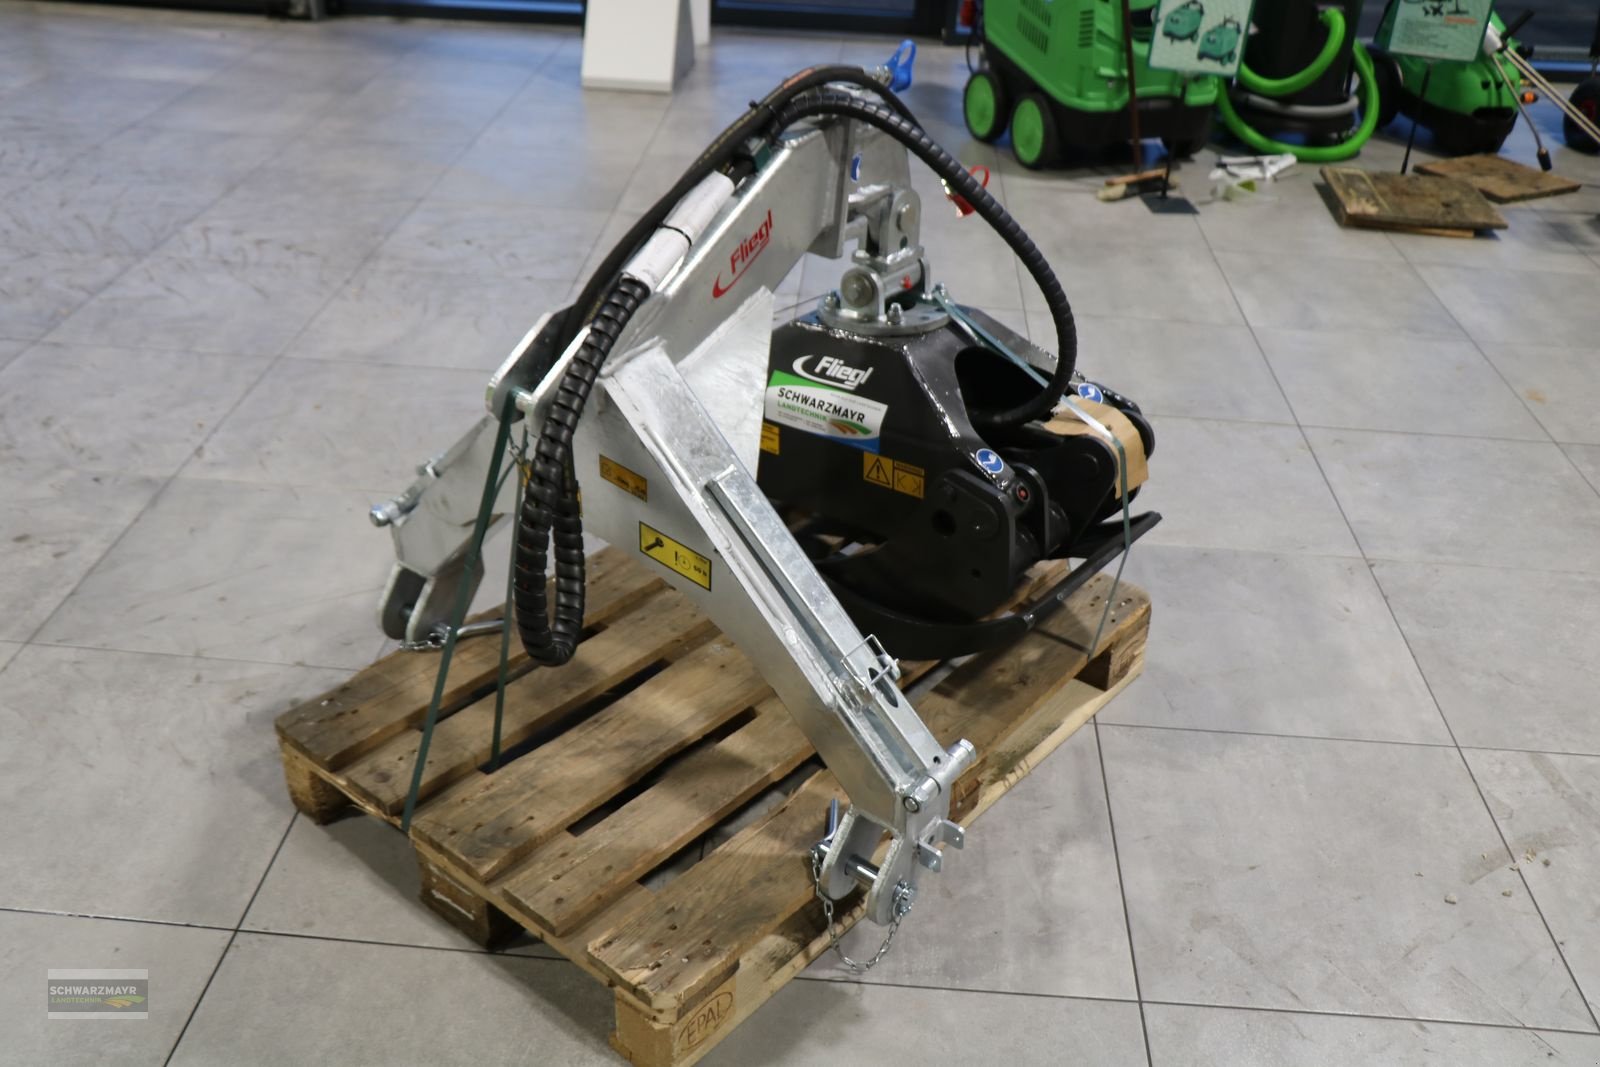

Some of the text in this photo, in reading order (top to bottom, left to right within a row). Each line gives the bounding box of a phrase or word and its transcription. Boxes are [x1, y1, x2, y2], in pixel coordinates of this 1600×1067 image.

[730, 207, 773, 274] Fliegl
[814, 355, 874, 389] Fliegl
[777, 400, 828, 422] LANDTECHNIK
[778, 387, 865, 424] SCHWARZMAYR
[687, 1000, 723, 1046] EPAL
